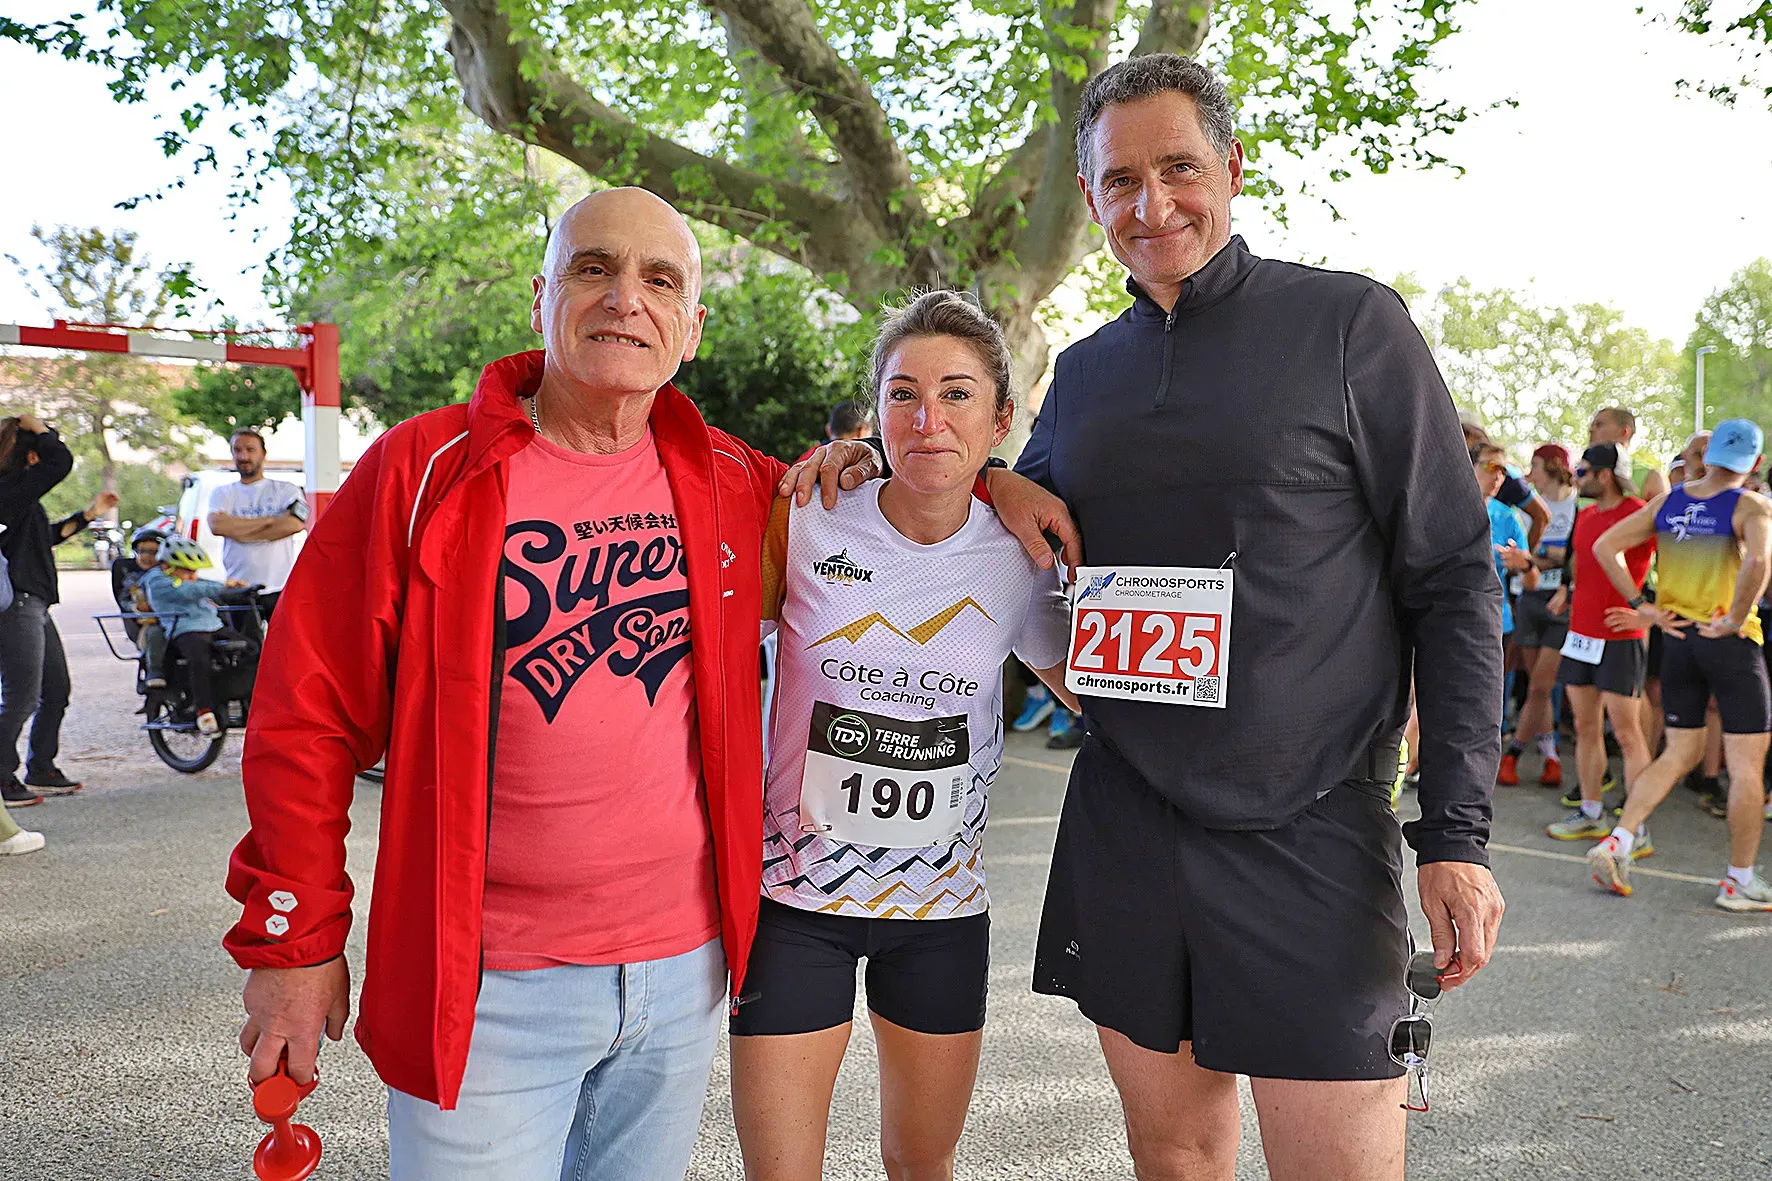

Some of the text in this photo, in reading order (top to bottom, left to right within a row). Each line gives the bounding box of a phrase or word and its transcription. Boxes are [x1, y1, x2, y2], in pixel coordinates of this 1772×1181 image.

[812, 560, 874, 583] VENTOUX
[1114, 589, 1183, 599] CHRONOMETRAGE
[1116, 576, 1225, 590] CHRONOSPORTS
[1073, 611, 1216, 678] 2125
[525, 623, 596, 698] DRY
[820, 658, 979, 697] Côte à Côte
[1076, 675, 1190, 695] chronosports.fr
[860, 687, 936, 709] Coaching
[834, 725, 866, 747] TDR
[874, 728, 921, 748] TERRE
[892, 744, 957, 761] RUNNING
[840, 772, 935, 821] 190
